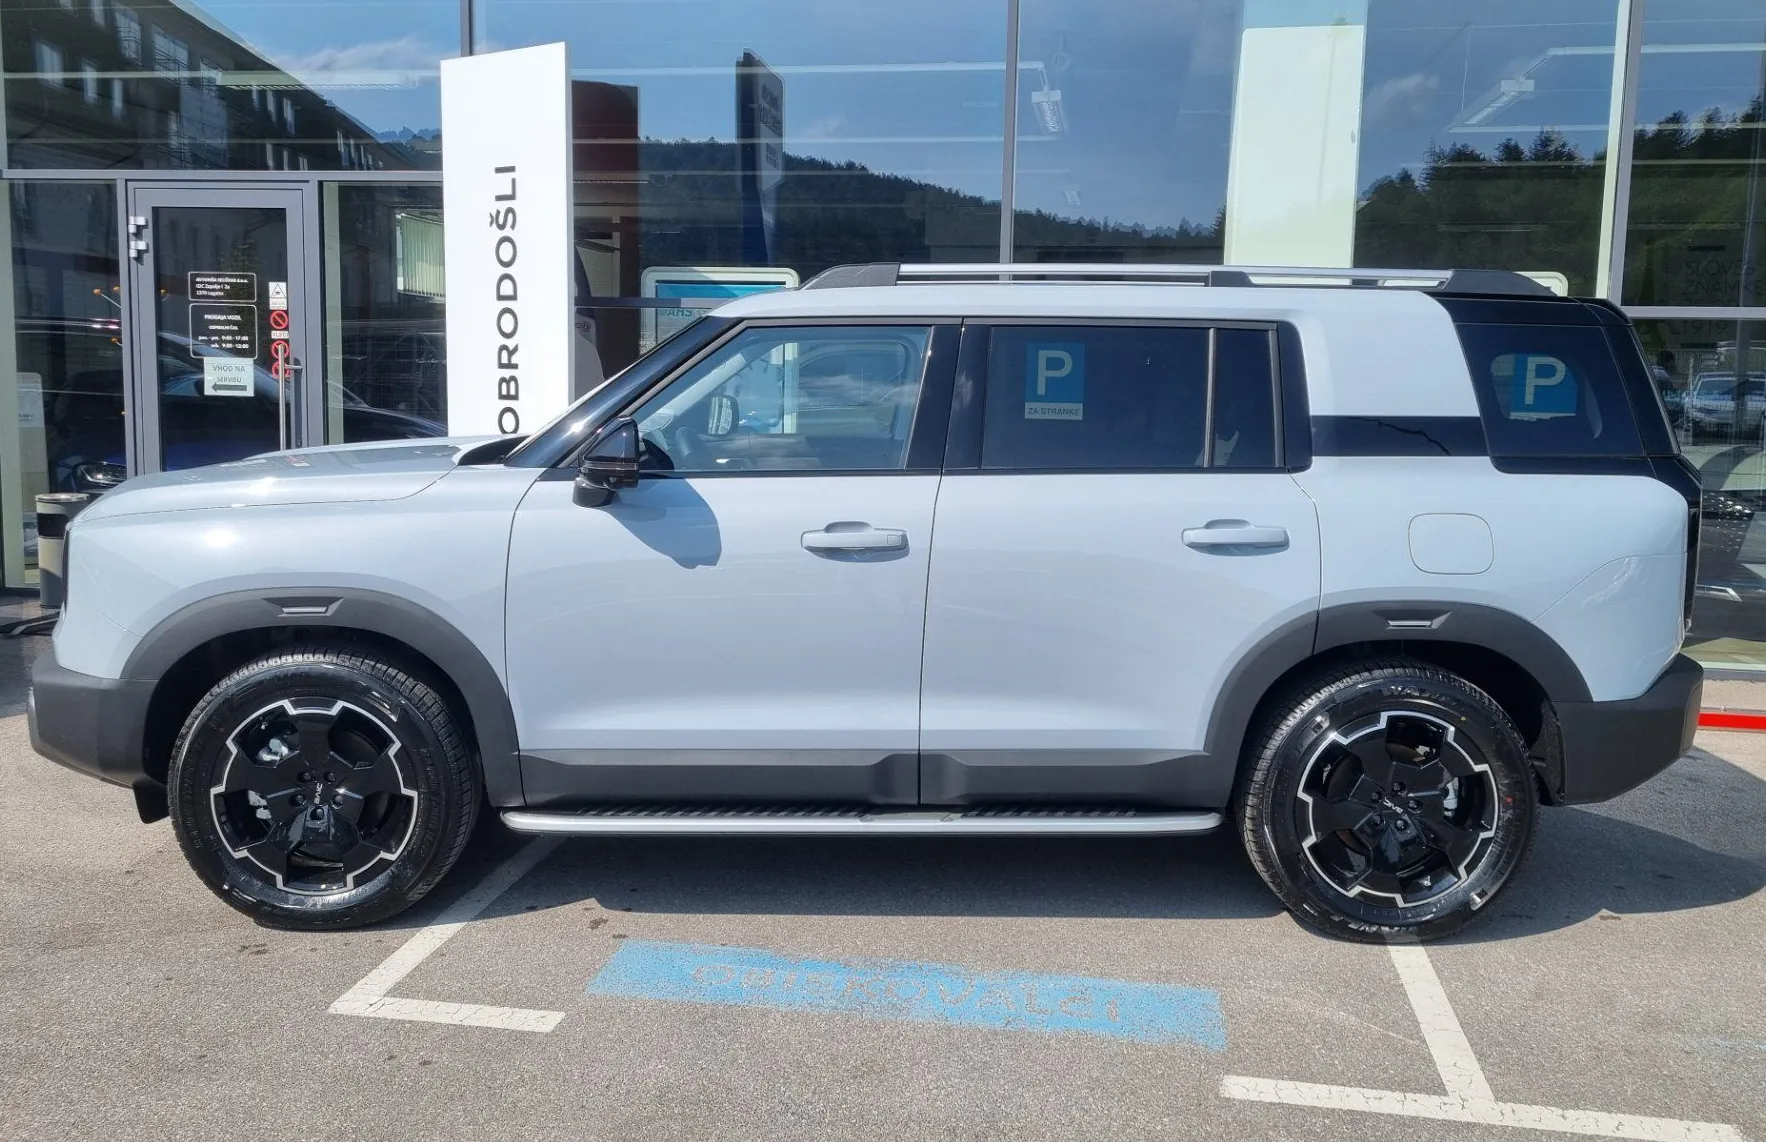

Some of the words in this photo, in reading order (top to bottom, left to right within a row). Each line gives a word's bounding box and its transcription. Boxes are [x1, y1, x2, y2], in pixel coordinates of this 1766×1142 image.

[1037, 350, 1073, 395] P
[1525, 356, 1566, 405] P
[1027, 407, 1038, 415] ZA
[1040, 407, 1080, 416] STRANKE
